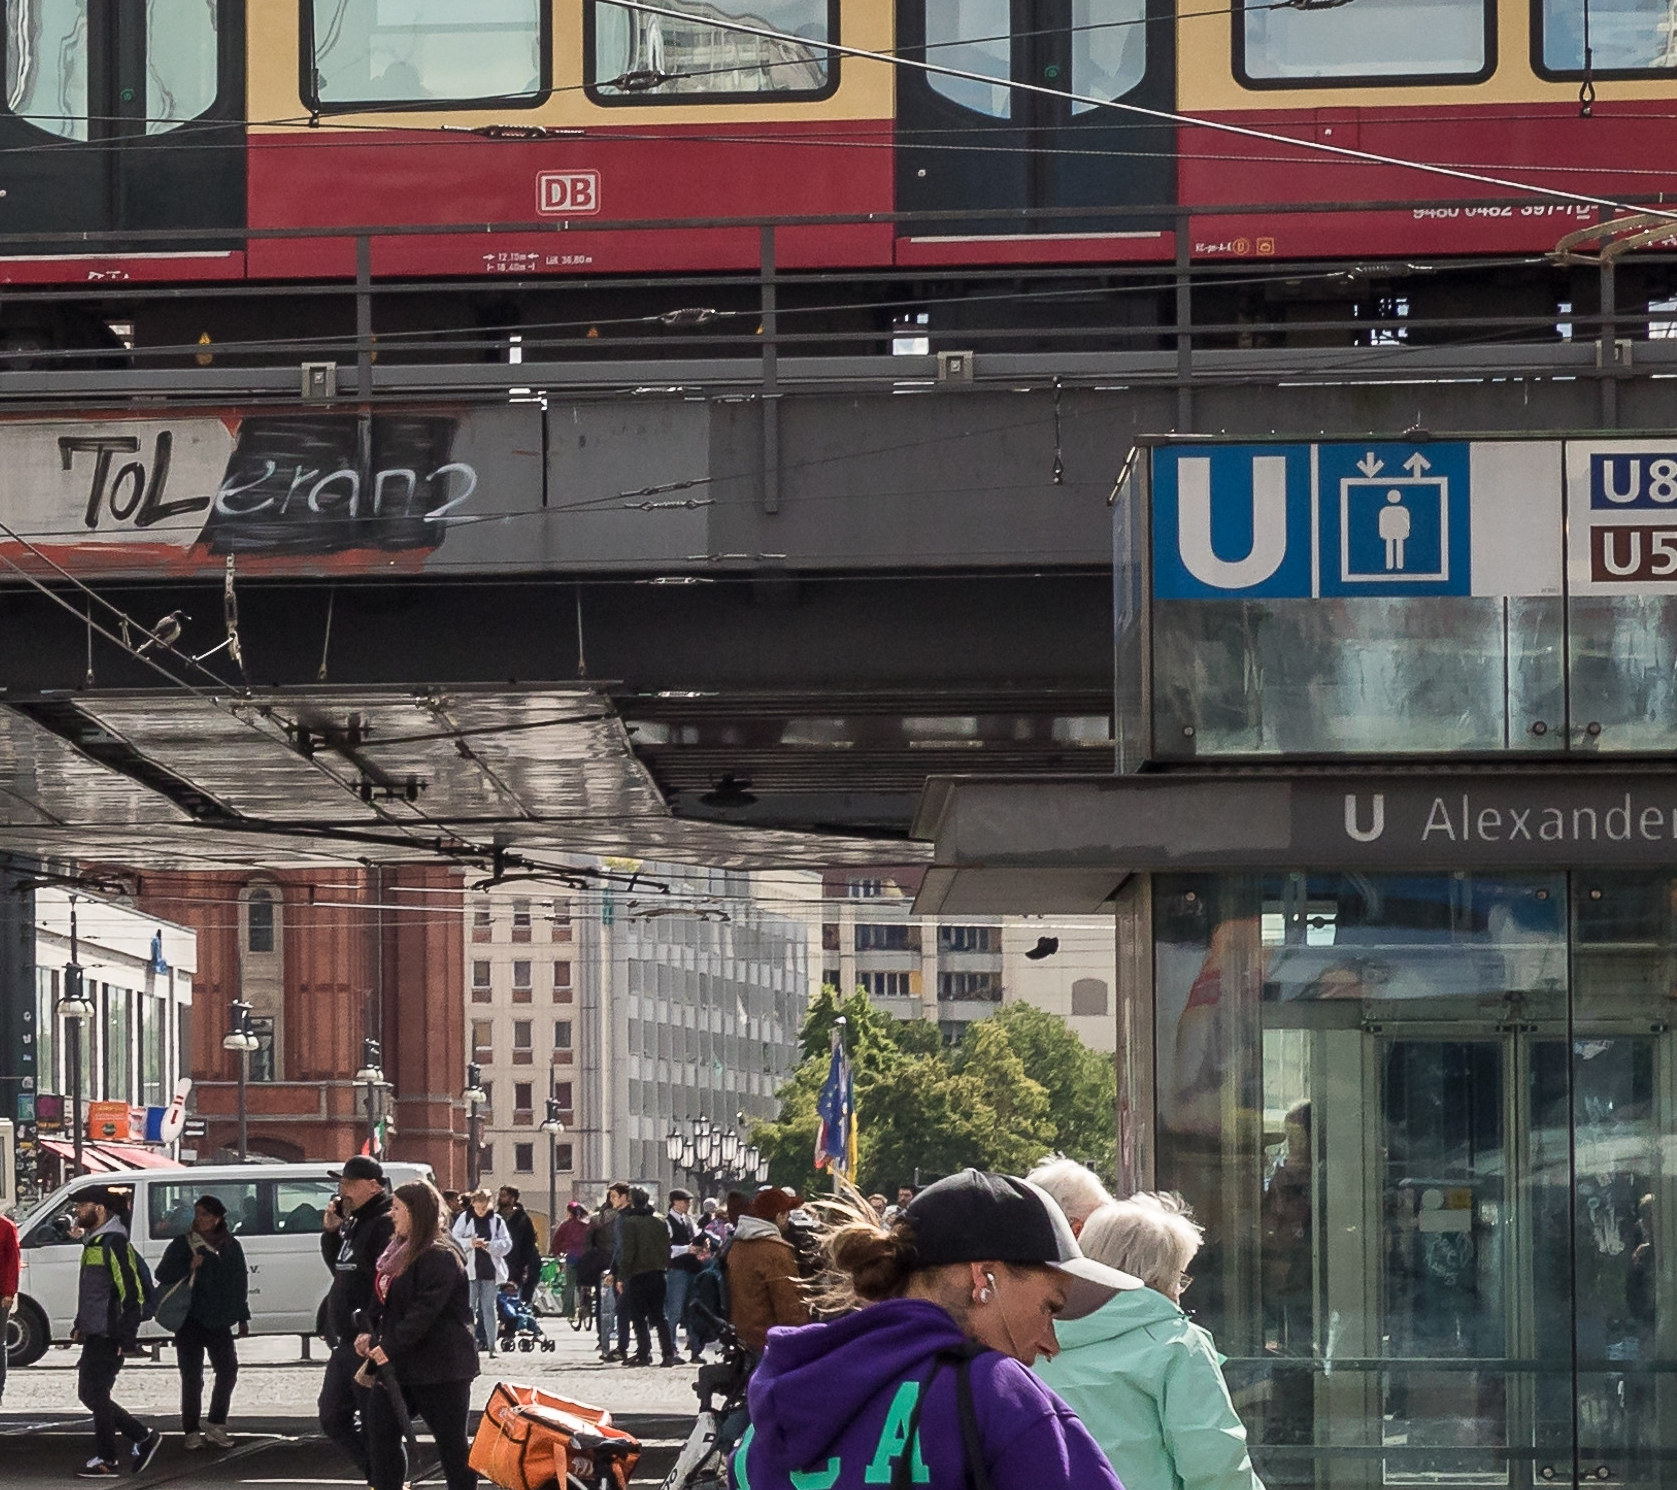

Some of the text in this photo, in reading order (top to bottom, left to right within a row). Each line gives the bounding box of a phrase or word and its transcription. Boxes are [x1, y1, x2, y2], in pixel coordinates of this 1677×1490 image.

[543, 175, 595, 210] DB
[1602, 459, 1677, 504] U8
[1178, 456, 1287, 589] U
[1602, 531, 1677, 575] U5
[1344, 792, 1677, 842] U Alexande
